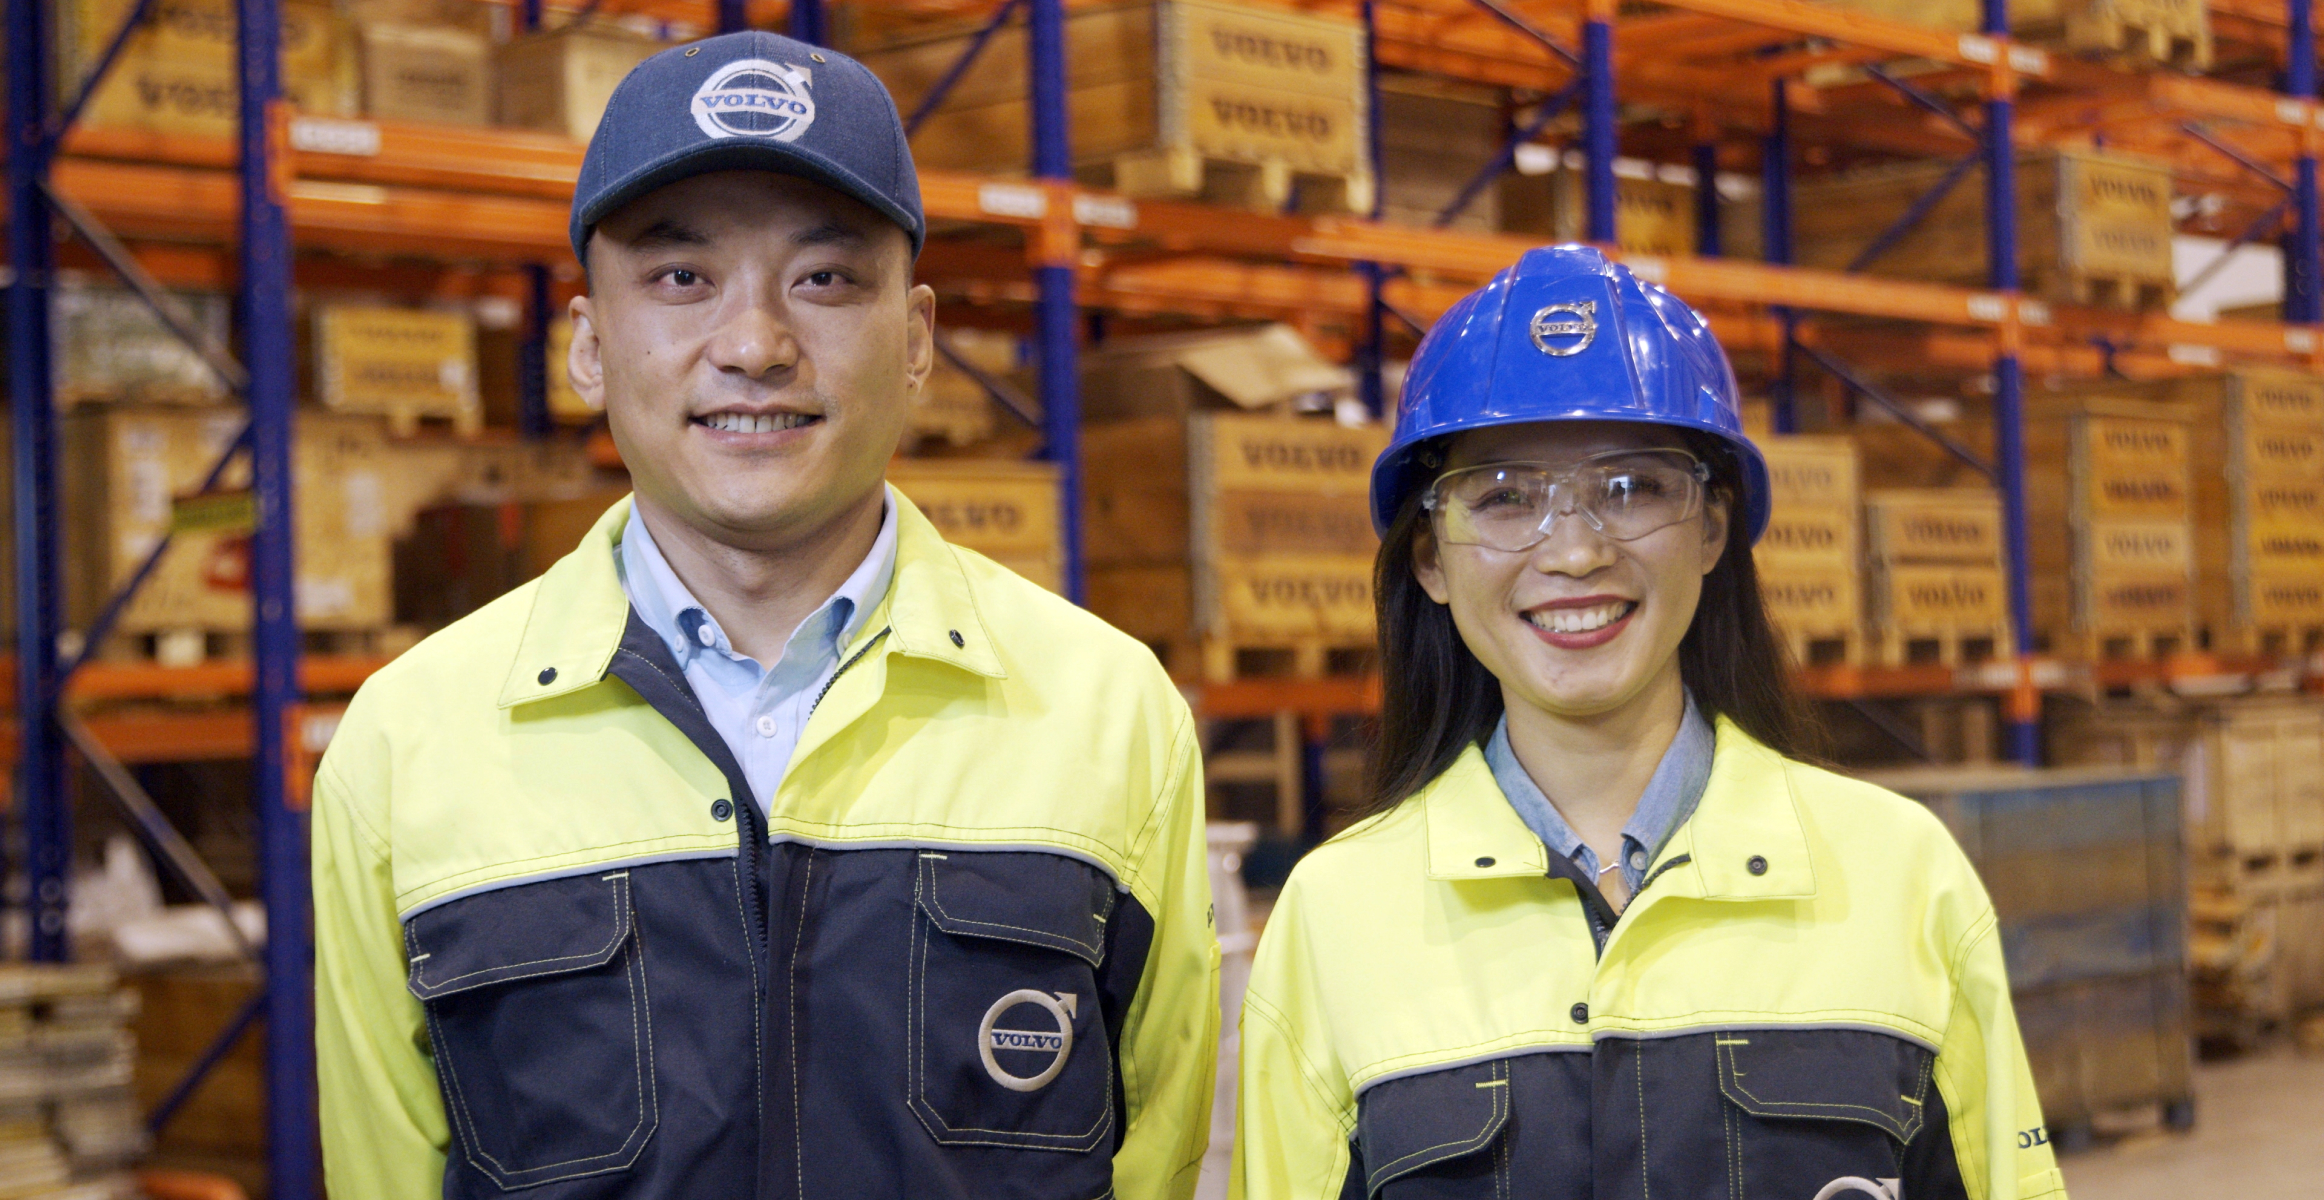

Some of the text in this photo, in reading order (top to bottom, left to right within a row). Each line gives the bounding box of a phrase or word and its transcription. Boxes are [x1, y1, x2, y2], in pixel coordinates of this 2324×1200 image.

[1210, 29, 1332, 74] VOLVO
[700, 94, 807, 115] VOLVO
[1210, 98, 1332, 144] VOLVO
[1537, 323, 1589, 334] VOLVO
[1242, 442, 1364, 473] VOLVO
[991, 1032, 1063, 1049] VOLVO
